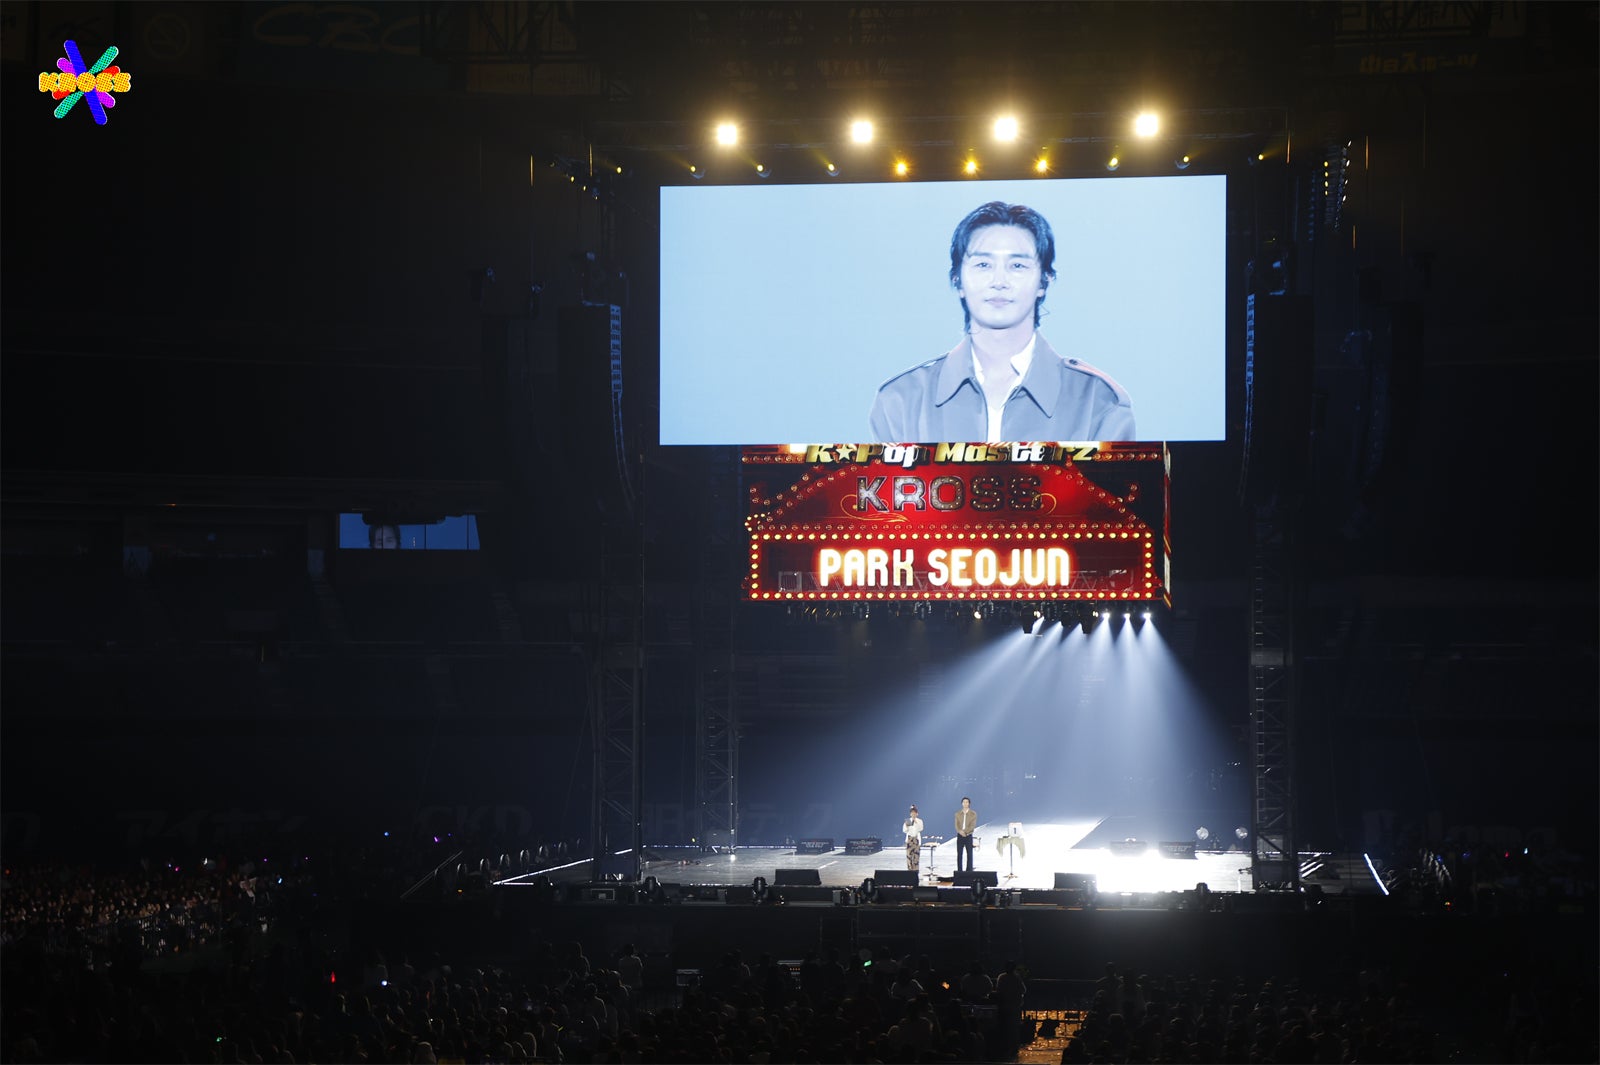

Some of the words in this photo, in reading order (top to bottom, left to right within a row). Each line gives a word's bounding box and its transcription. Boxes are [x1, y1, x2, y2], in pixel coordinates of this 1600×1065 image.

[856, 476, 1042, 512] KROSS
[820, 549, 914, 586] PARK
[927, 548, 1070, 586] SEOJUN
